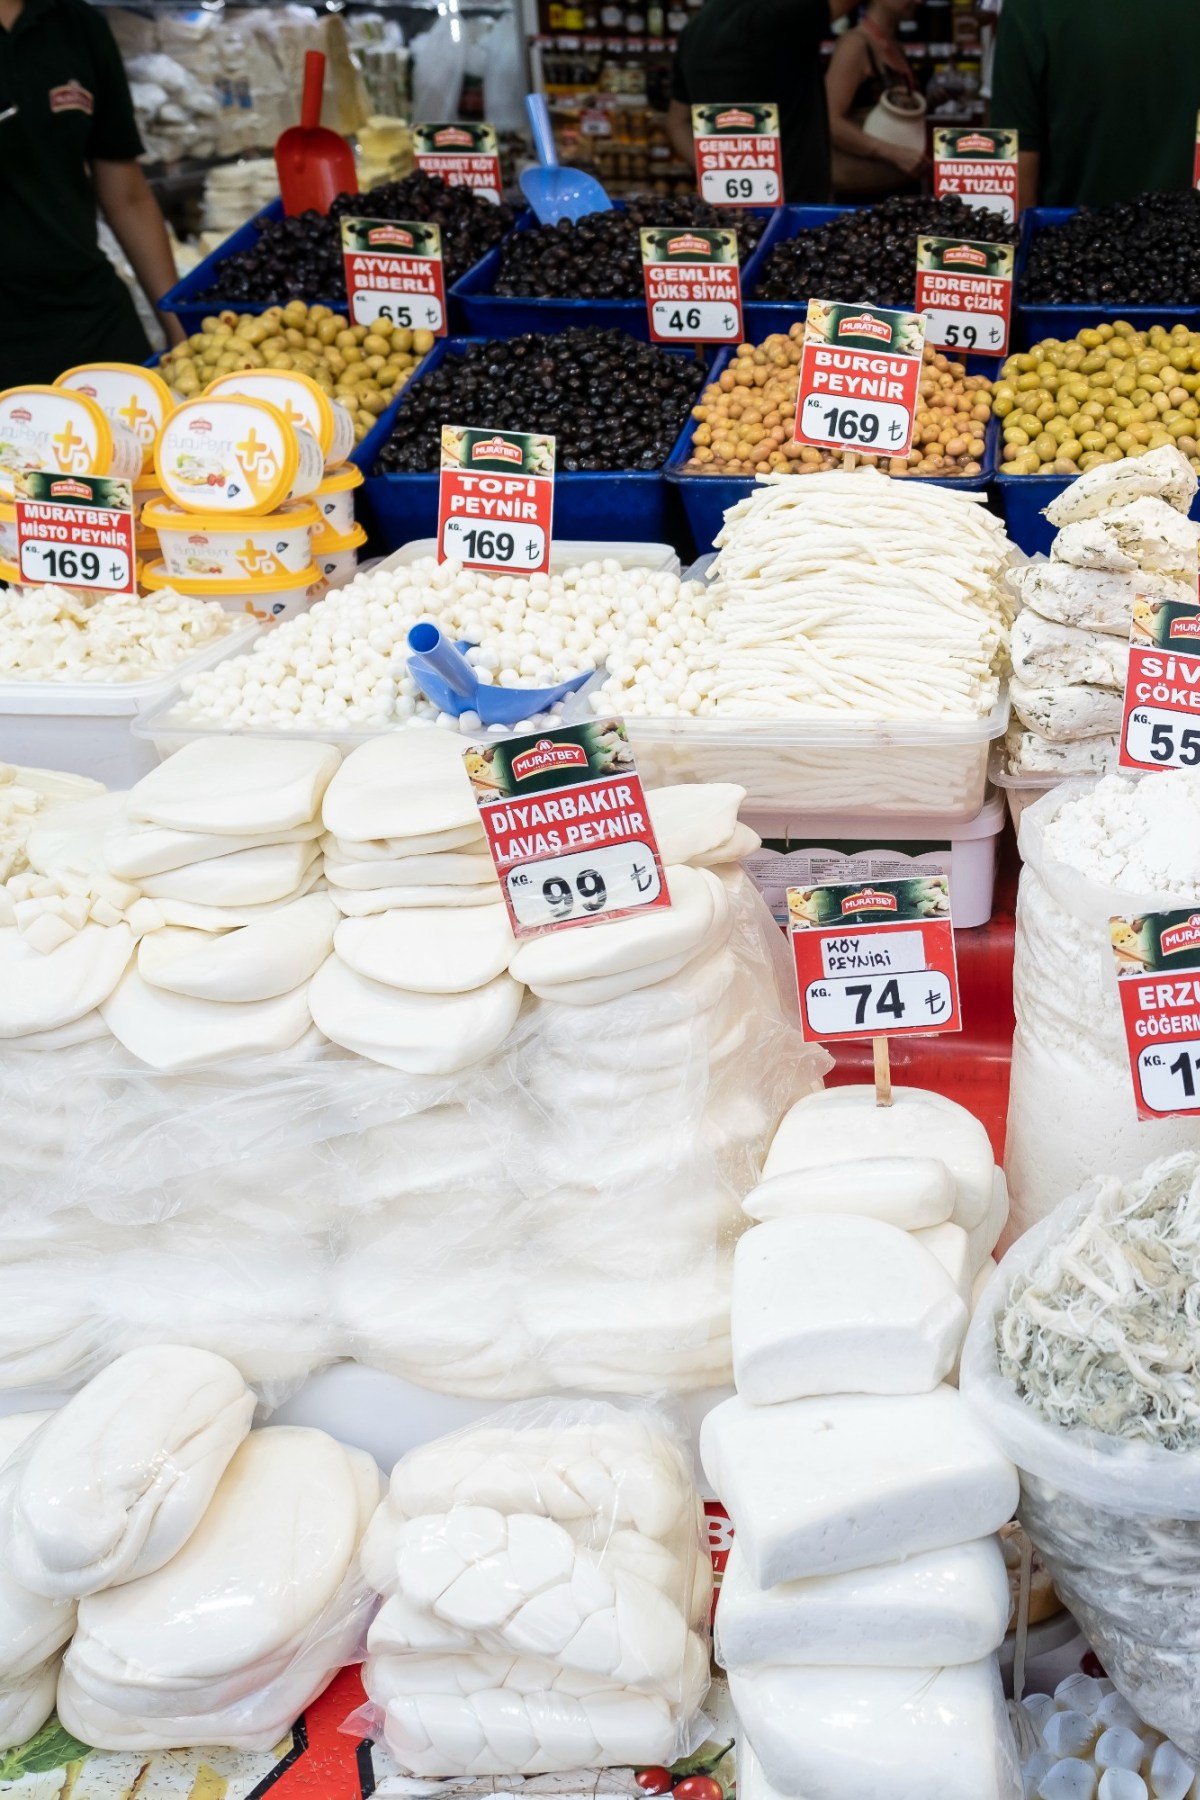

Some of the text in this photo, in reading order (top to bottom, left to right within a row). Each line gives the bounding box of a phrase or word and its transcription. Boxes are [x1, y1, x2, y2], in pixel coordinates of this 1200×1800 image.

[699, 138, 753, 151] GEMLİK
[702, 152, 775, 168] SİYAH
[939, 164, 1016, 178] MUDANYA
[725, 179, 752, 198] 69
[938, 179, 1015, 194] AZ TUZLU
[353, 257, 432, 275] AYVALIK
[649, 265, 732, 282] GEMLİK
[354, 273, 435, 293] BİBERLİ
[649, 281, 737, 300] LÜKS SİYAH
[923, 275, 1004, 293] EDREMİT
[921, 290, 1004, 313] LÜKS ÇİZİK
[379, 305, 413, 328] 65
[670, 309, 701, 332] 46
[842, 321, 890, 336] MURATBEY
[944, 325, 977, 349] 59
[815, 351, 908, 376] BURGU
[813, 371, 904, 399] PEYNİR
[823, 408, 880, 443] 169
[457, 475, 537, 497] TOPİ
[25, 504, 121, 527] MURATBEY
[451, 498, 538, 520] PEYNİR
[22, 522, 128, 547] MİSTO PEYNİR
[463, 529, 515, 561] 169
[42, 549, 100, 581] 169
[1133, 713, 1152, 725] KG.
[517, 749, 581, 771] MURATBEY
[491, 785, 632, 835] DİYARBAKIR
[566, 811, 647, 847] PEYNİR
[511, 875, 533, 886] KG.
[542, 868, 608, 918] 99
[845, 896, 893, 909] MURATBEY
[826, 938, 860, 954] KÖY
[811, 988, 832, 998] KG.
[845, 979, 906, 1025] 74
[1144, 1055, 1167, 1067] KG.
